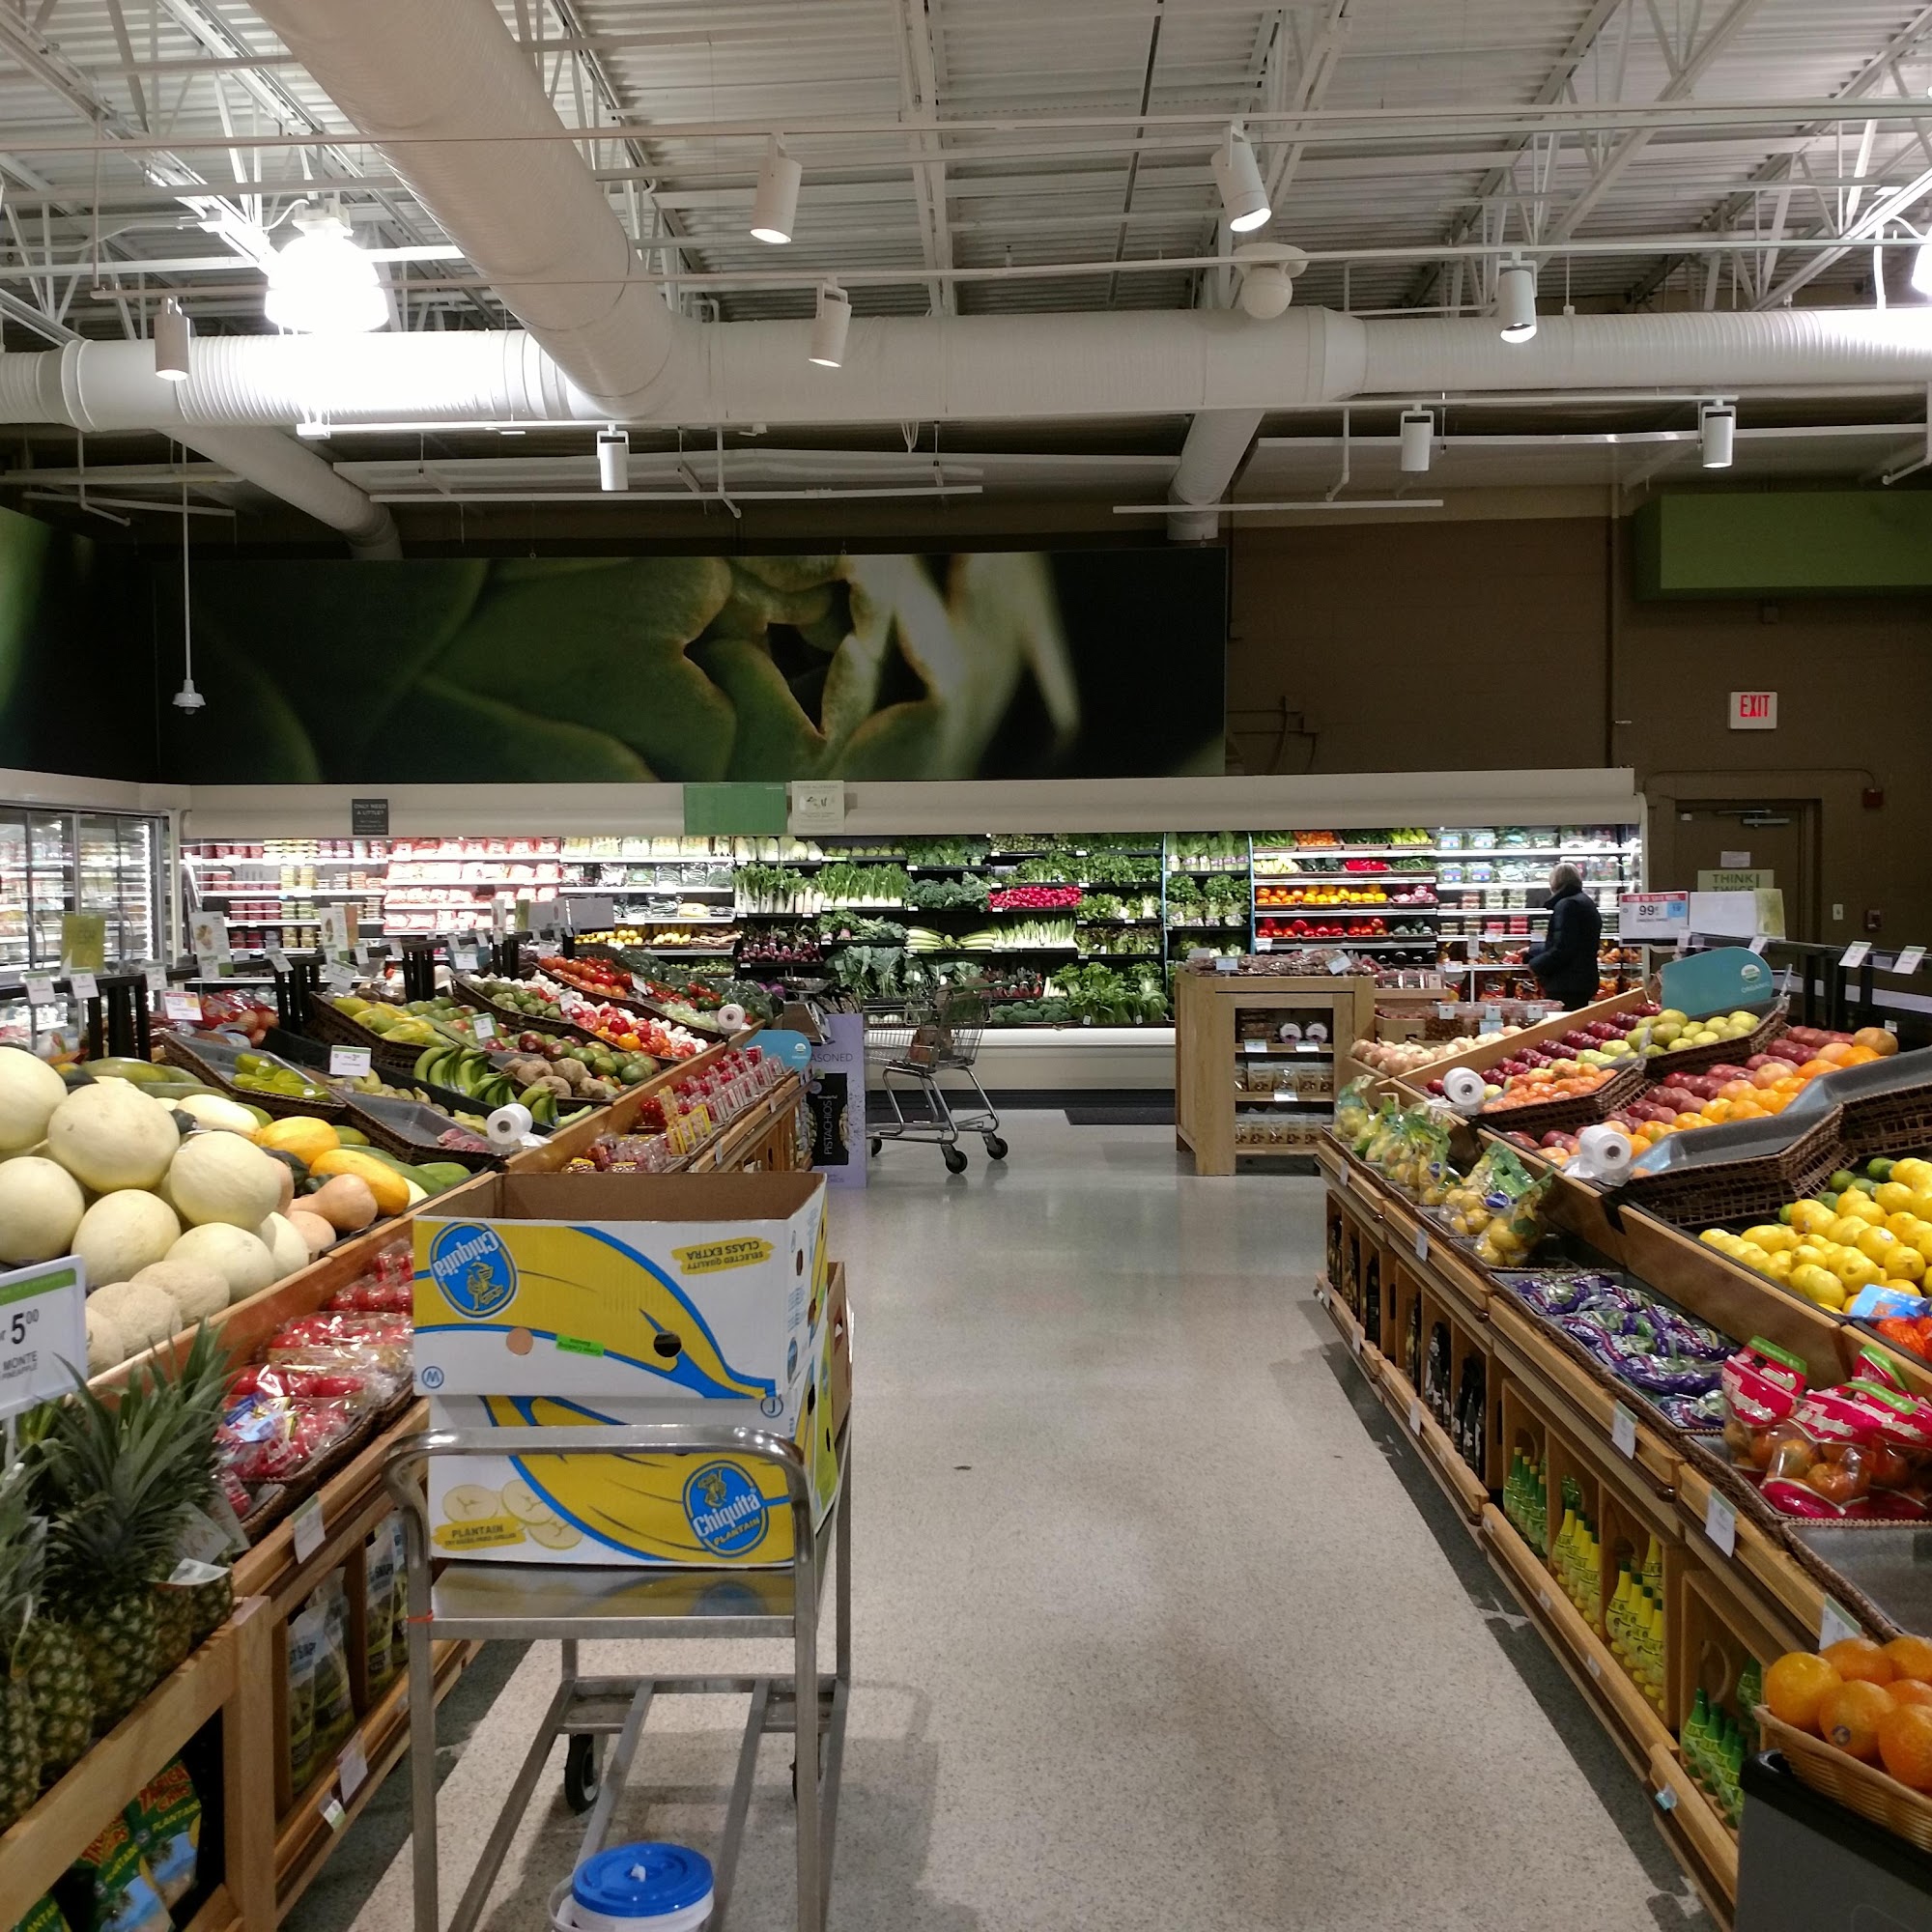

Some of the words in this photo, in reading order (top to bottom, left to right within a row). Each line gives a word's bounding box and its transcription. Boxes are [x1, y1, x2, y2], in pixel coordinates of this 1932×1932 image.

[1740, 695, 1770, 718] EXIT
[1712, 873, 1754, 884] THINK
[811, 1052, 853, 1063] ASONED
[824, 1098, 833, 1155] PISTACHIOS
[433, 1230, 499, 1277] Chiquita
[686, 1246, 724, 1261] EXTRA
[724, 1240, 760, 1255] CLASS
[687, 1257, 723, 1270] QUALITY
[724, 1251, 764, 1264] SELECTED
[3, 1350, 38, 1371] MONTE
[693, 1493, 761, 1538] Chiquita
[451, 1523, 504, 1538] PLANTAIN
[714, 1517, 760, 1546] PLANTAIN
